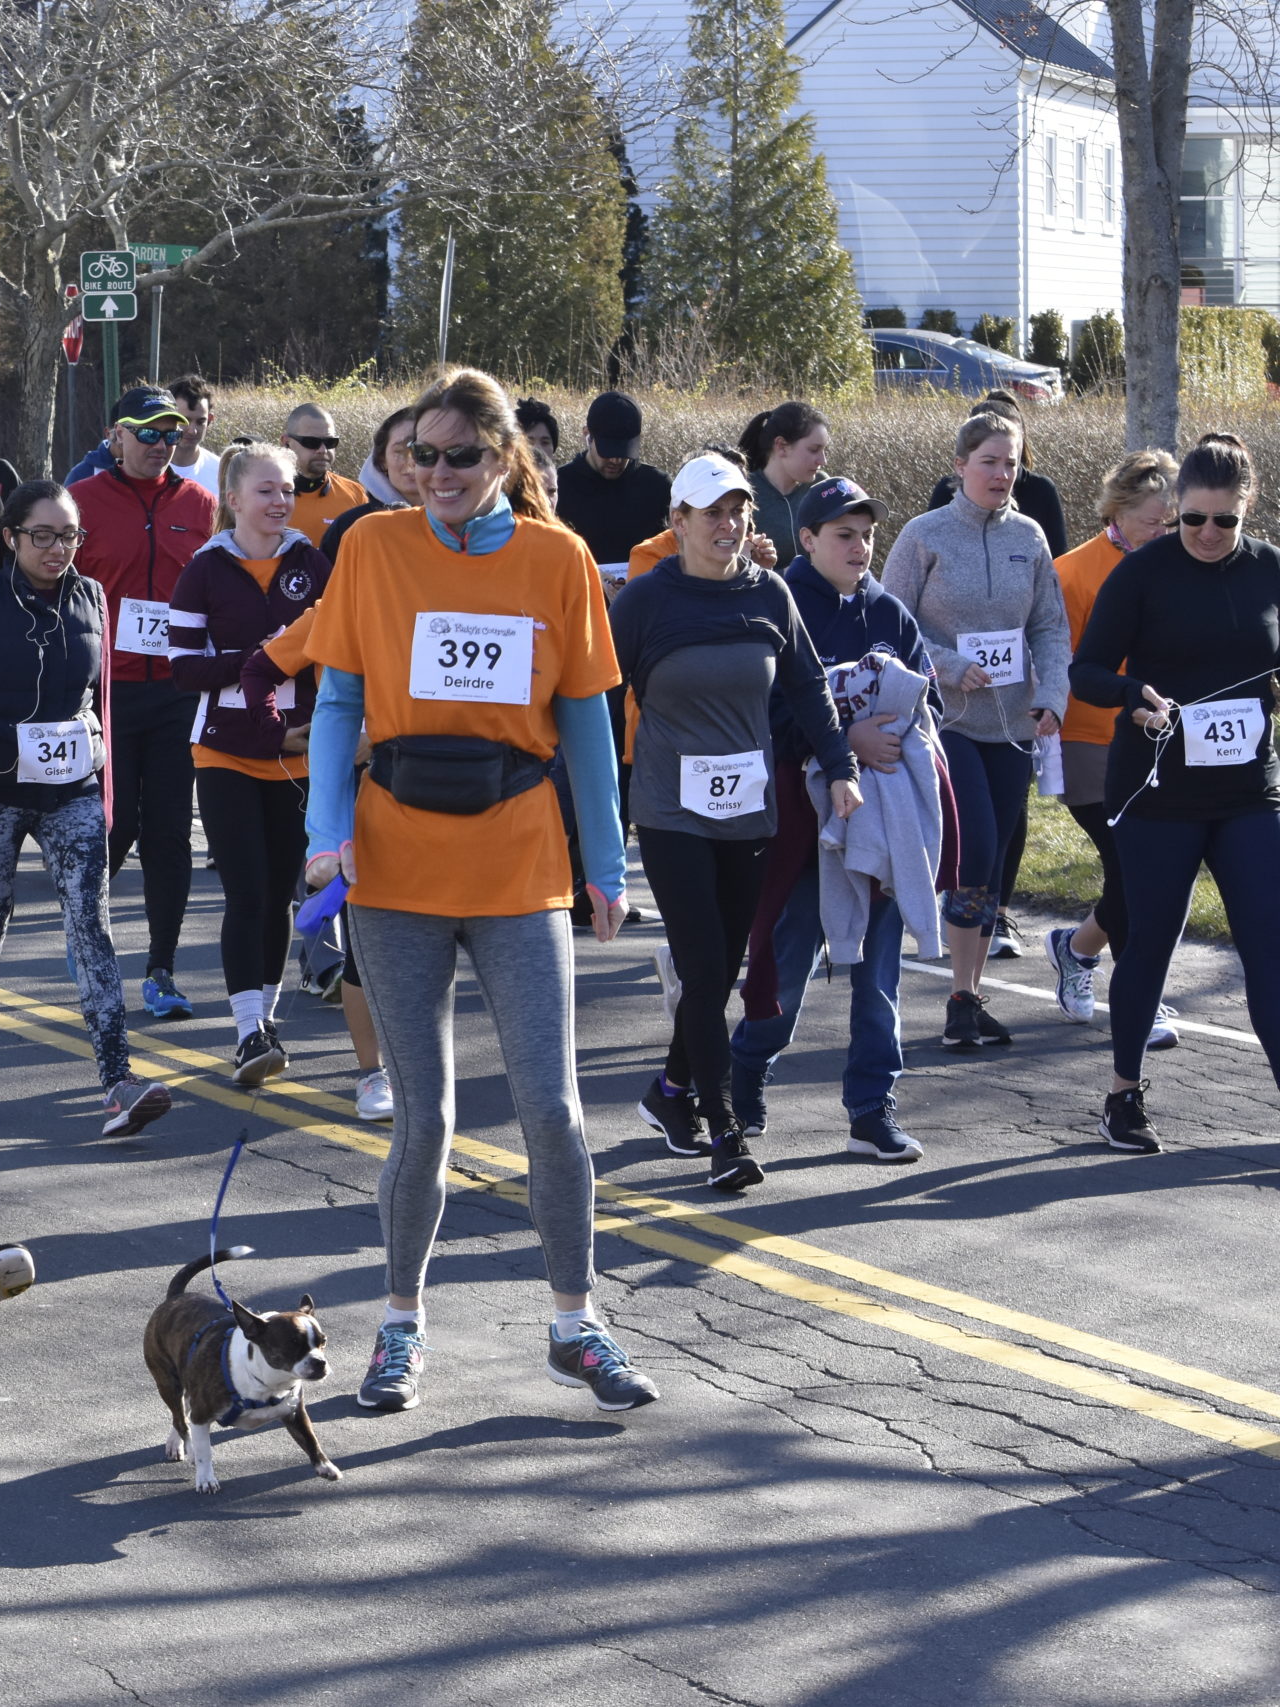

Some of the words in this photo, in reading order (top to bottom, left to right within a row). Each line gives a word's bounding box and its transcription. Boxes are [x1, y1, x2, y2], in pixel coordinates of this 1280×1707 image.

[84, 281, 102, 291] BIKE
[107, 281, 132, 290] ROUTE
[136, 616, 170, 637] 173
[141, 638, 162, 648] Scott
[438, 639, 502, 671] 399
[975, 647, 1012, 668] 364
[444, 675, 495, 690] Deirdre
[1204, 719, 1247, 743] 431
[37, 740, 77, 763] 341
[1216, 747, 1242, 757] Kerry
[44, 766, 73, 776] Gisele
[709, 774, 741, 797] 87
[707, 801, 743, 811] Chrissy
